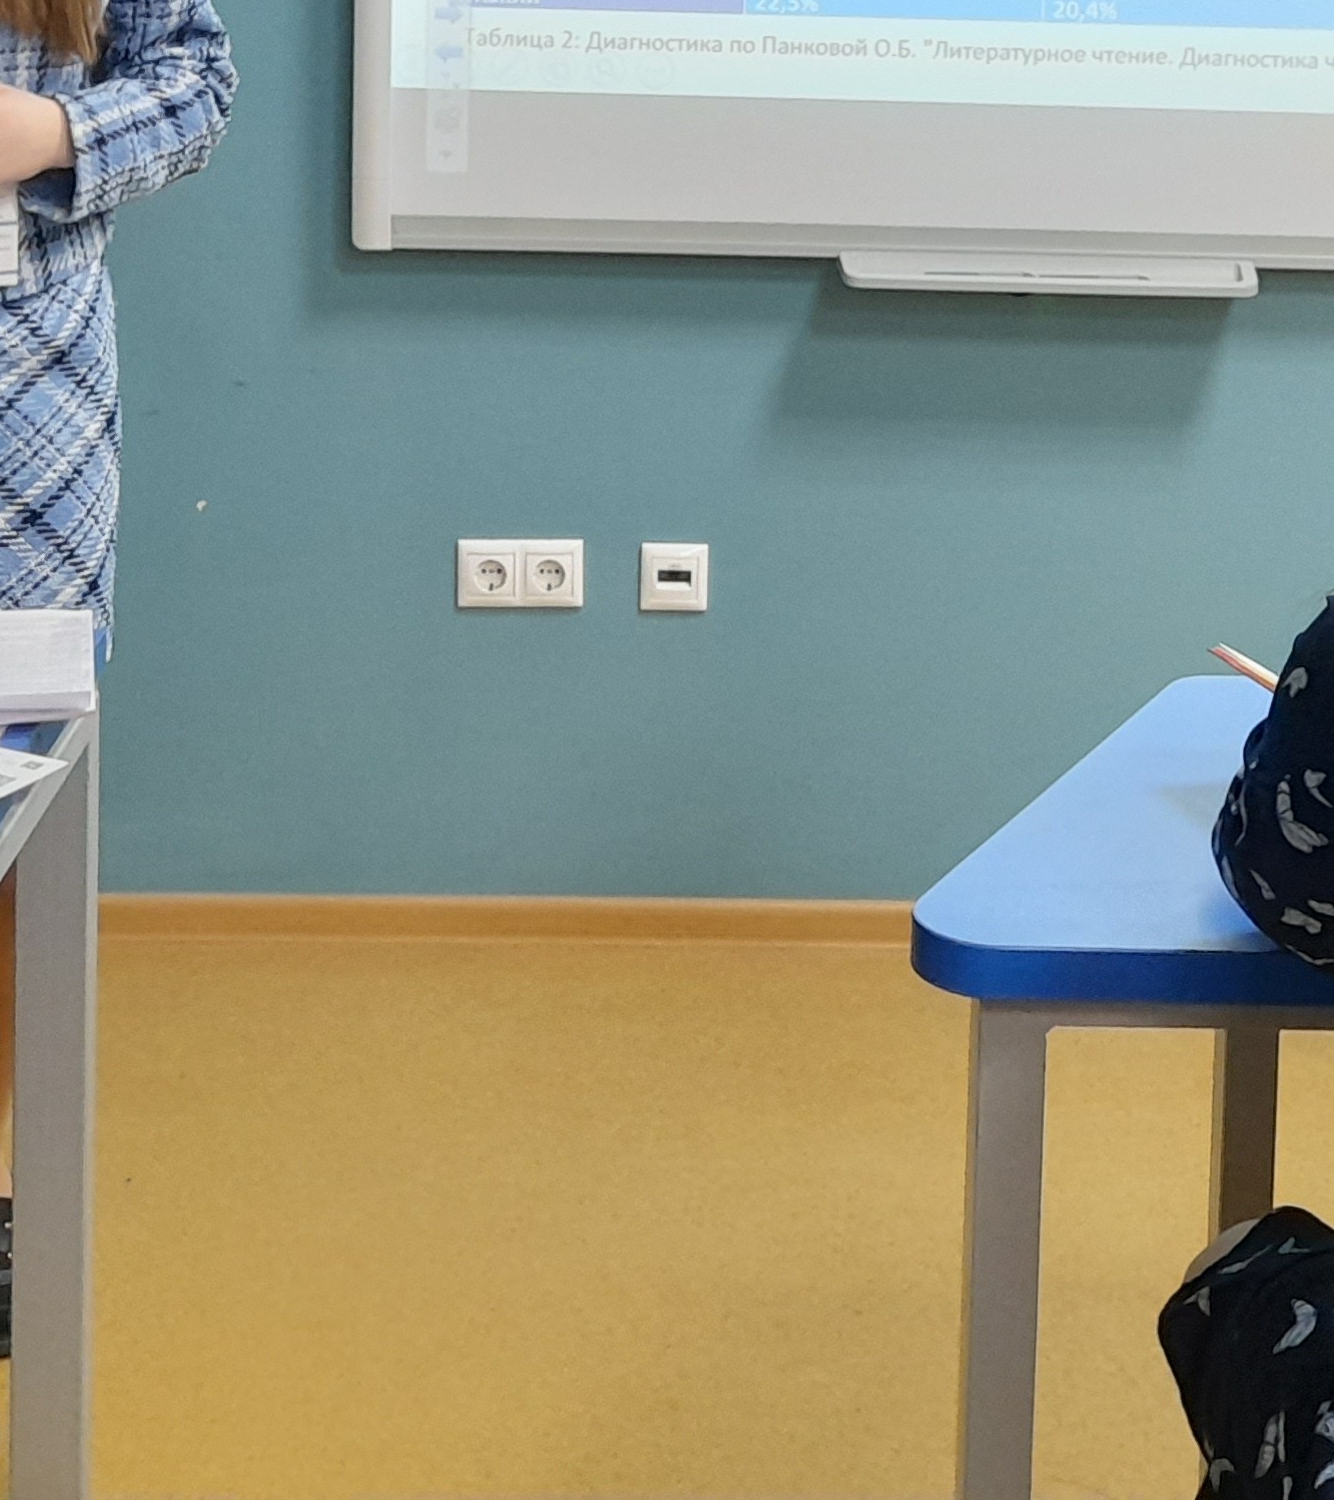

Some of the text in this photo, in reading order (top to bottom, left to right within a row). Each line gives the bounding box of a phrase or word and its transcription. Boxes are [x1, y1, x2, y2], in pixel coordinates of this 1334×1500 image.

[467, 27, 555, 53] Таблица
[561, 29, 579, 49] 2:
[585, 30, 723, 54] Диагностика
[730, 39, 756, 55] по
[762, 35, 868, 57] Панковой
[874, 38, 916, 60] О.Б.
[924, 38, 1086, 66] "Литературное
[1092, 49, 1173, 66] чтение.
[1179, 46, 1318, 71] Диагностика
